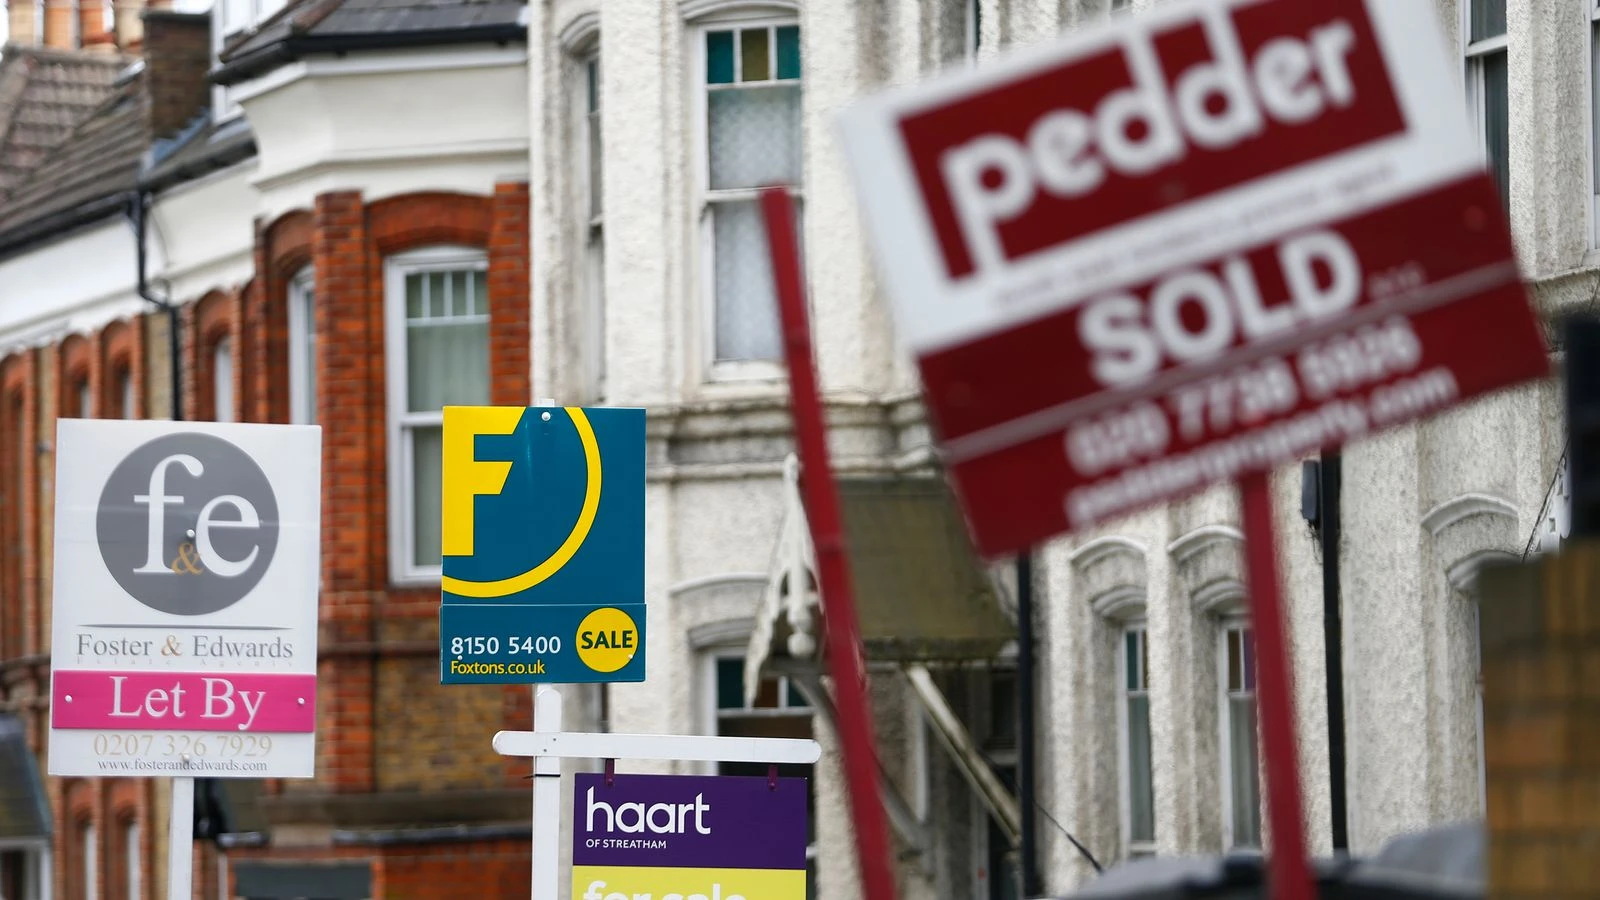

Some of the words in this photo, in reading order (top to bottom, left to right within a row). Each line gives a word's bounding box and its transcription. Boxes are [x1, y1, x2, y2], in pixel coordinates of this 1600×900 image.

[938, 0, 1359, 278] pedder
[1076, 228, 1364, 390] SOLD
[76, 633, 153, 657] Foster
[160, 634, 183, 657] &
[192, 635, 293, 658] Edwards
[451, 636, 500, 655] 8150
[508, 636, 561, 654] 5400
[581, 630, 633, 650] SALE
[451, 659, 545, 675] Foxtons.co.uk
[108, 676, 186, 718] Let
[199, 677, 266, 731] By
[93, 734, 153, 756] 0207
[162, 735, 207, 757] 326
[216, 735, 273, 757] 7929
[97, 758, 267, 772] www.fosterandedwards.com
[586, 786, 711, 834] haart
[586, 839, 601, 848] OF
[603, 839, 667, 849] STREATHAM
